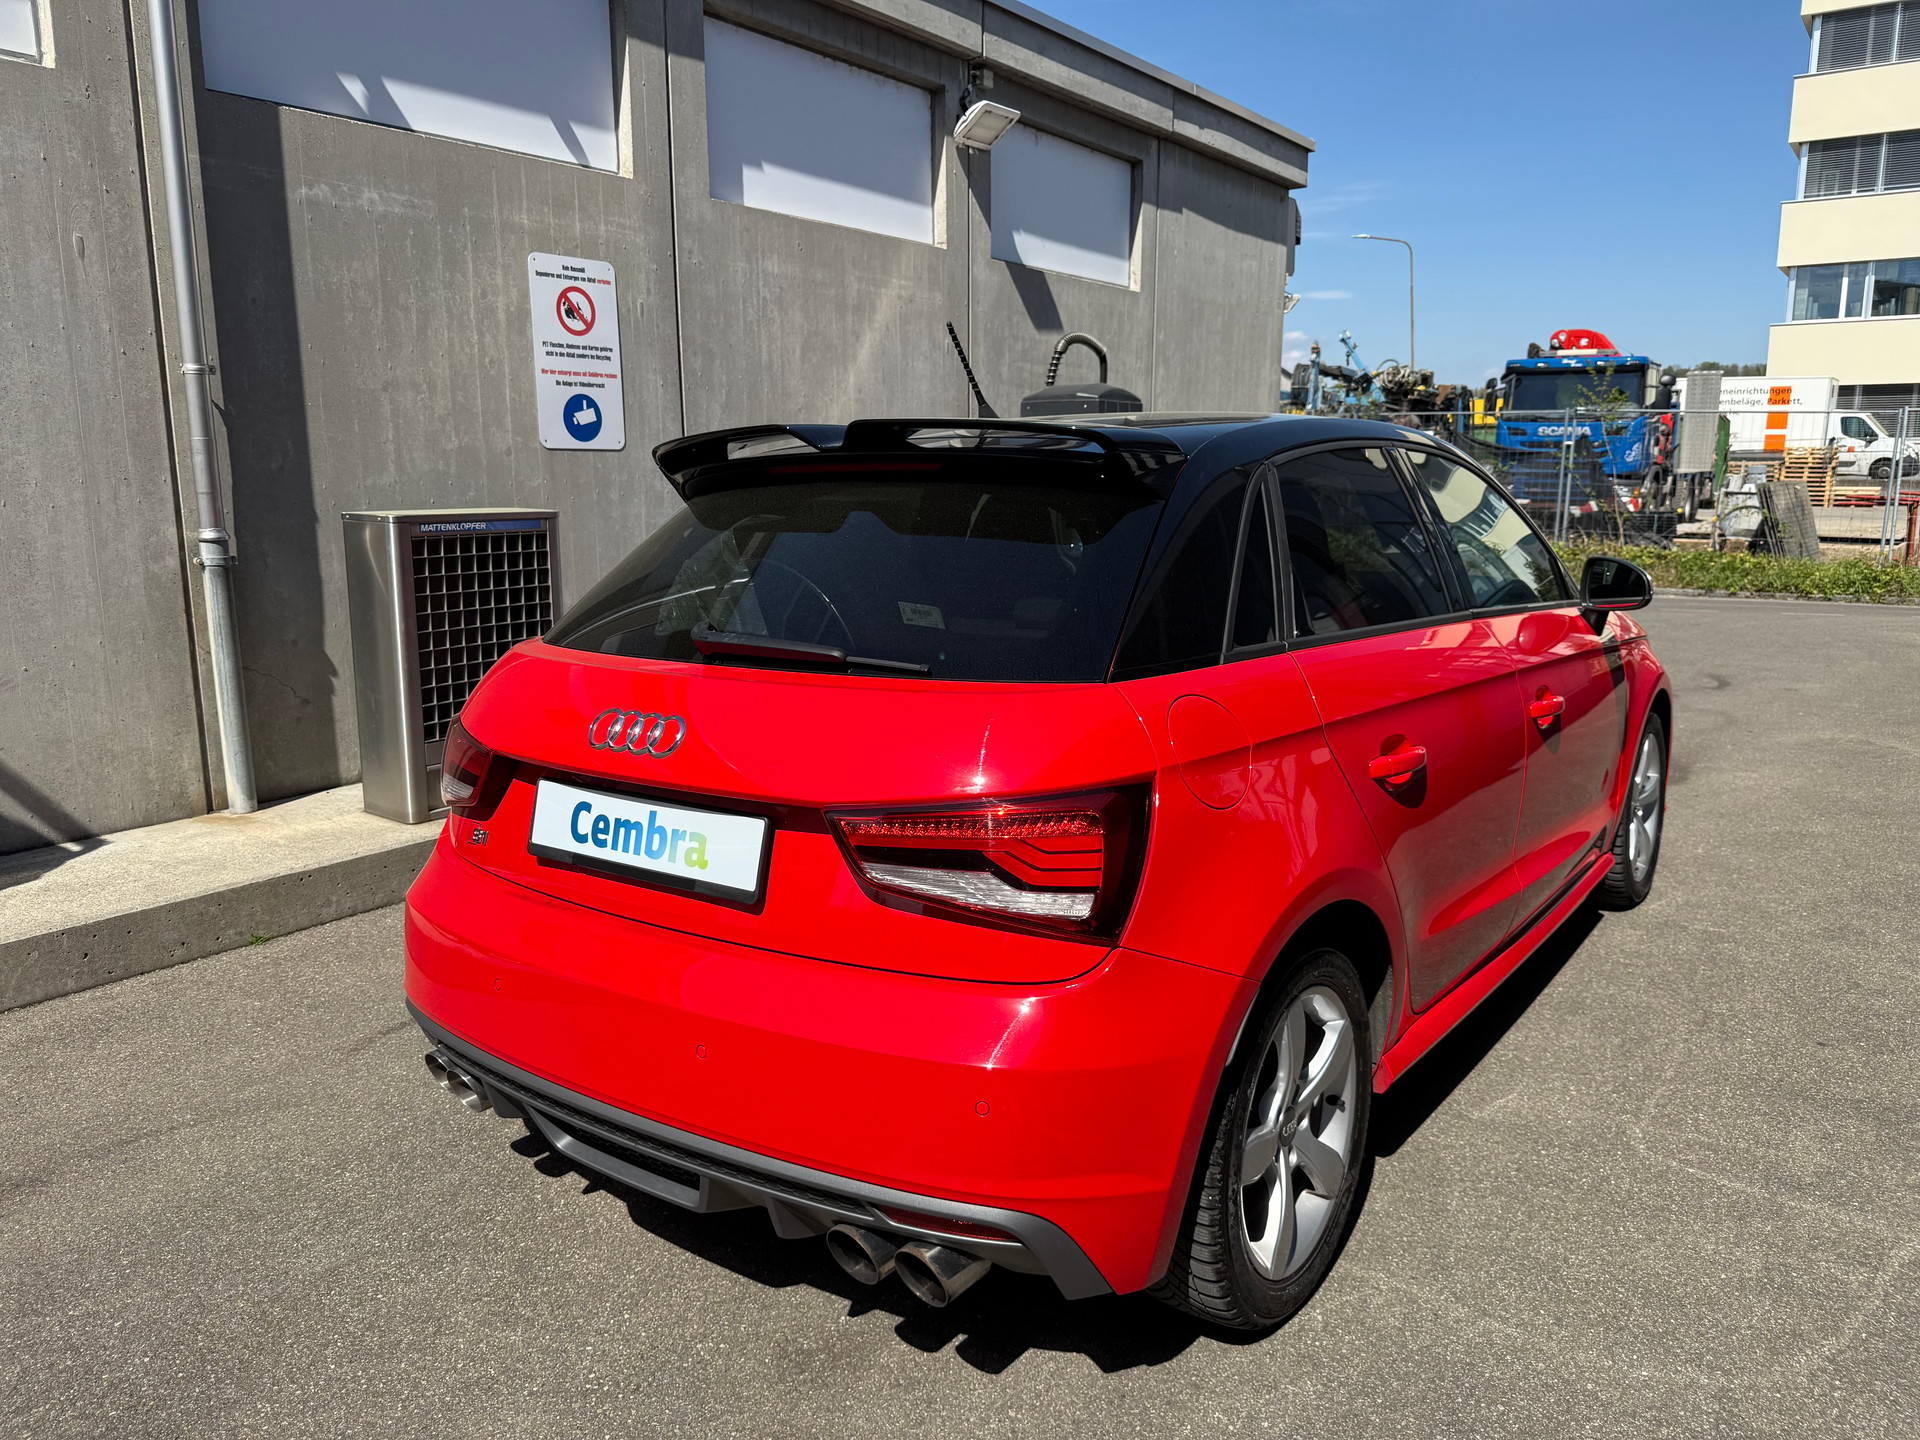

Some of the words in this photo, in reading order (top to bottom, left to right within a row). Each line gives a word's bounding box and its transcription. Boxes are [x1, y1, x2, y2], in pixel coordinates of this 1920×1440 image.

[563, 273, 579, 282] Entsorgen
[595, 354, 611, 362] Recycling
[1767, 397, 1803, 406] Parkett,
[1537, 426, 1592, 436] SCANIA
[420, 522, 486, 532] MATTENKLOPFER
[570, 801, 709, 870] Cembra
